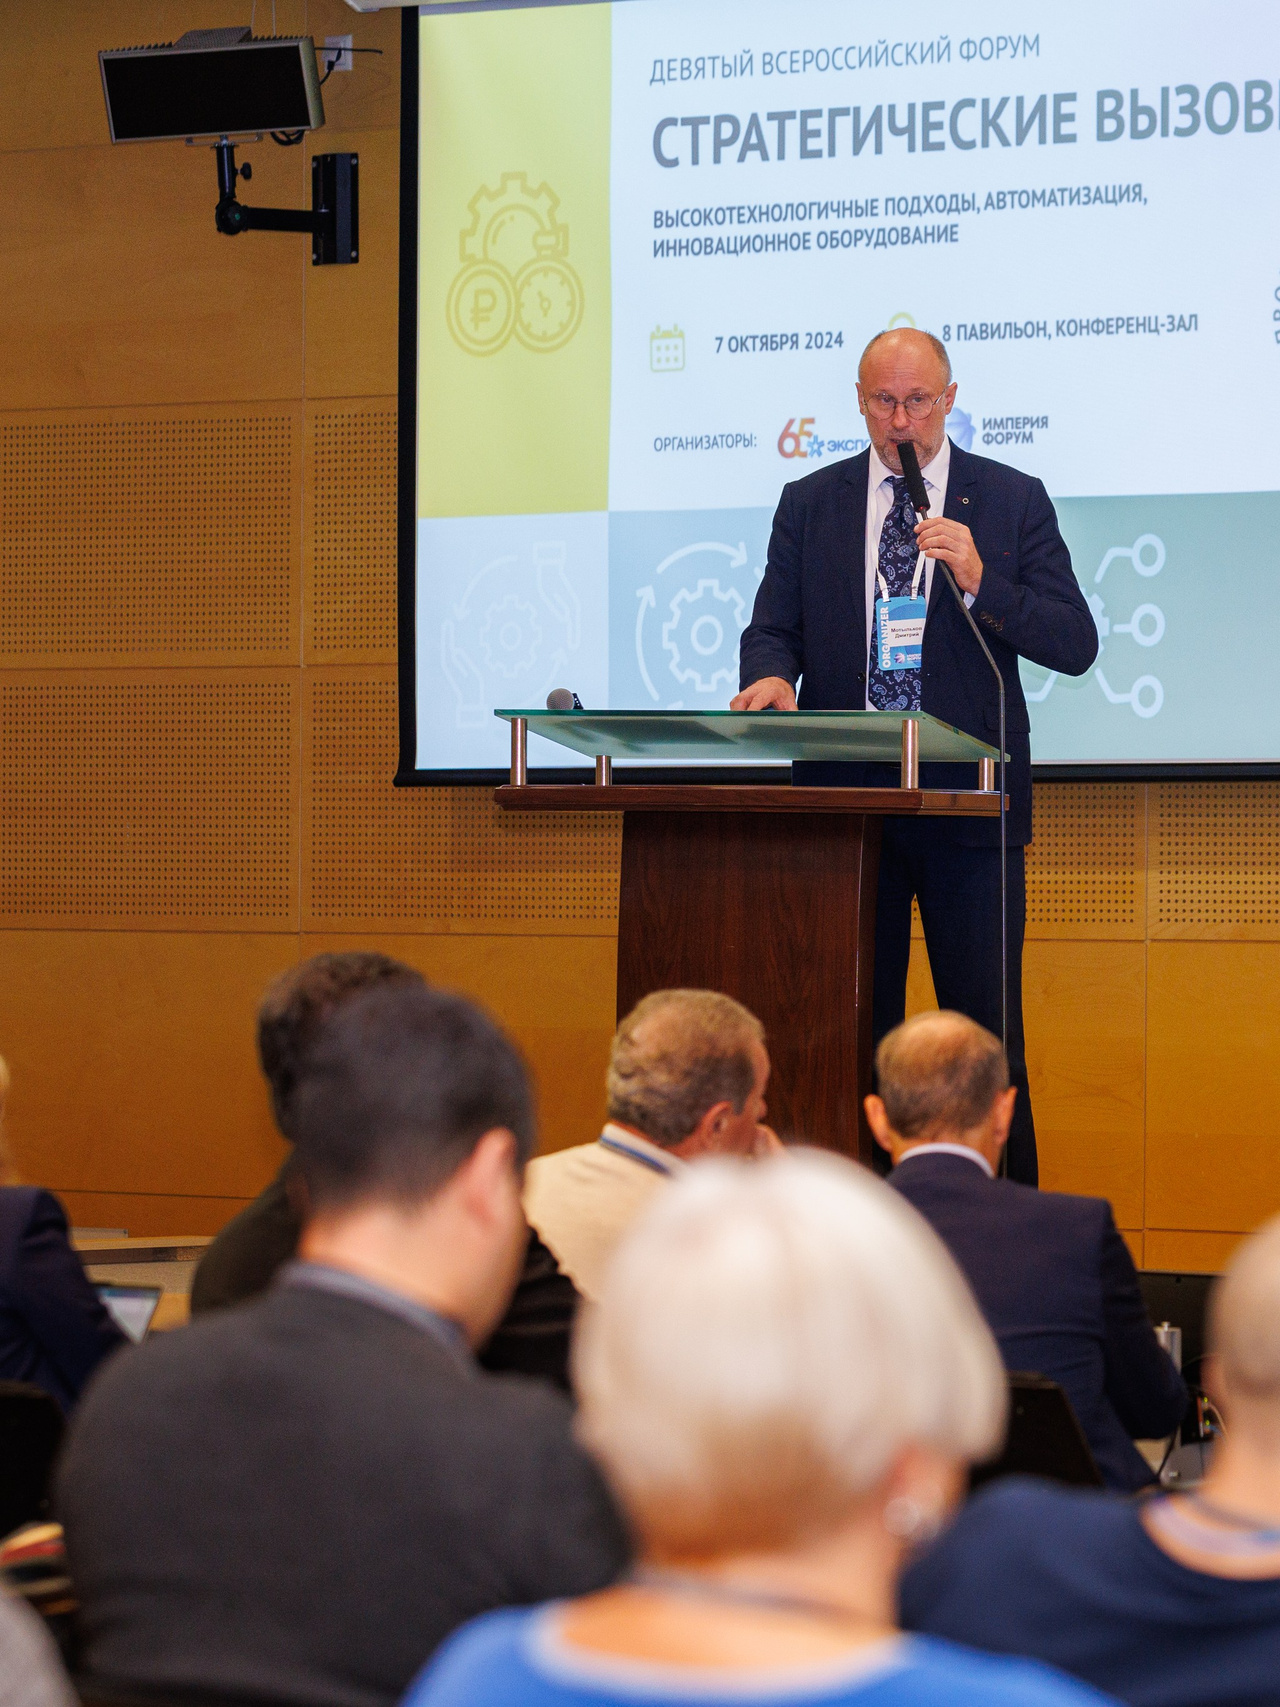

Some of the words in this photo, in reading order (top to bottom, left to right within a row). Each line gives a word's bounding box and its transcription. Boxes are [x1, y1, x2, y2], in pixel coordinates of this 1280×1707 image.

[650, 49, 753, 86] ДЕВЯТЫЙ
[762, 35, 951, 76] ВСЕРОССИЙСКИЙ
[959, 33, 1041, 62] ФОРУМ
[652, 92, 1078, 168] СТРАТЕГИЧЕСКИЕ
[653, 198, 879, 229] ВЫСОКОТЕХНОЛОГИЧНЫЕ
[884, 192, 981, 219] ПОДХОДЫ,
[984, 183, 1148, 211] АВТОМАТИЗАЦИЯ,
[653, 232, 811, 258] ИННОВАЦИОННОЕ
[816, 224, 959, 250] ОБОРУДОВАНИЕ
[715, 336, 724, 353] 7
[728, 333, 799, 352] ОКТЯБРЯ
[805, 331, 844, 350] 2024
[942, 324, 951, 342] 8
[957, 320, 1052, 341] ПАВИЛЬОН,
[1056, 314, 1198, 336] КОНФЕРЕНЦ-ЗАЛ
[982, 416, 1048, 430] ИМПЕРИЯ
[982, 430, 1034, 446] ФОРУМ
[654, 433, 757, 452] ОРГАНИЗАТОРЫ:
[880, 606, 891, 668] ORGANIZER
